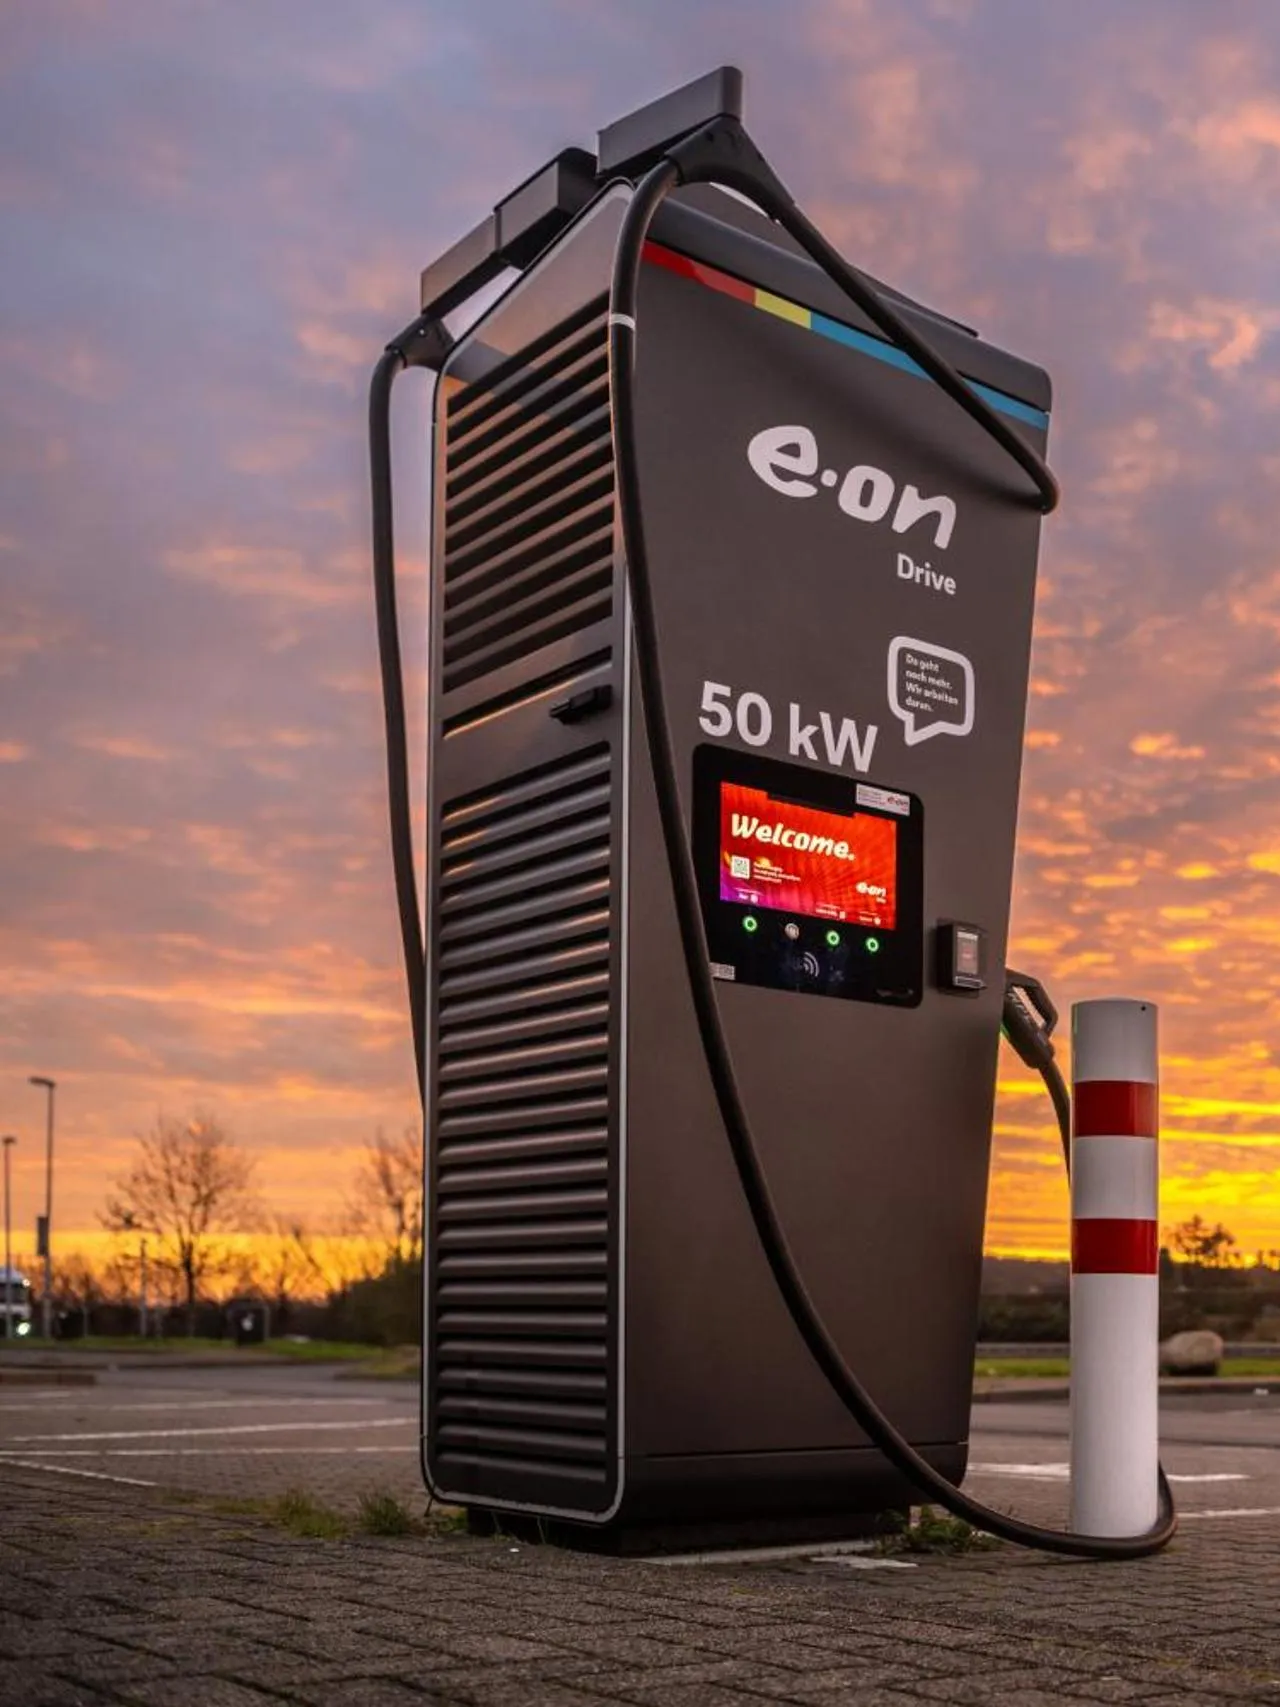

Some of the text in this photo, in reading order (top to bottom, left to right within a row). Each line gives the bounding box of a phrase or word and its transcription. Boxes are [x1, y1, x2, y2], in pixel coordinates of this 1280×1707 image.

[897, 553, 956, 595] Drive
[924, 689, 959, 705] arbeiten
[699, 680, 878, 773] 50 kW
[731, 813, 855, 861] Welcome.
